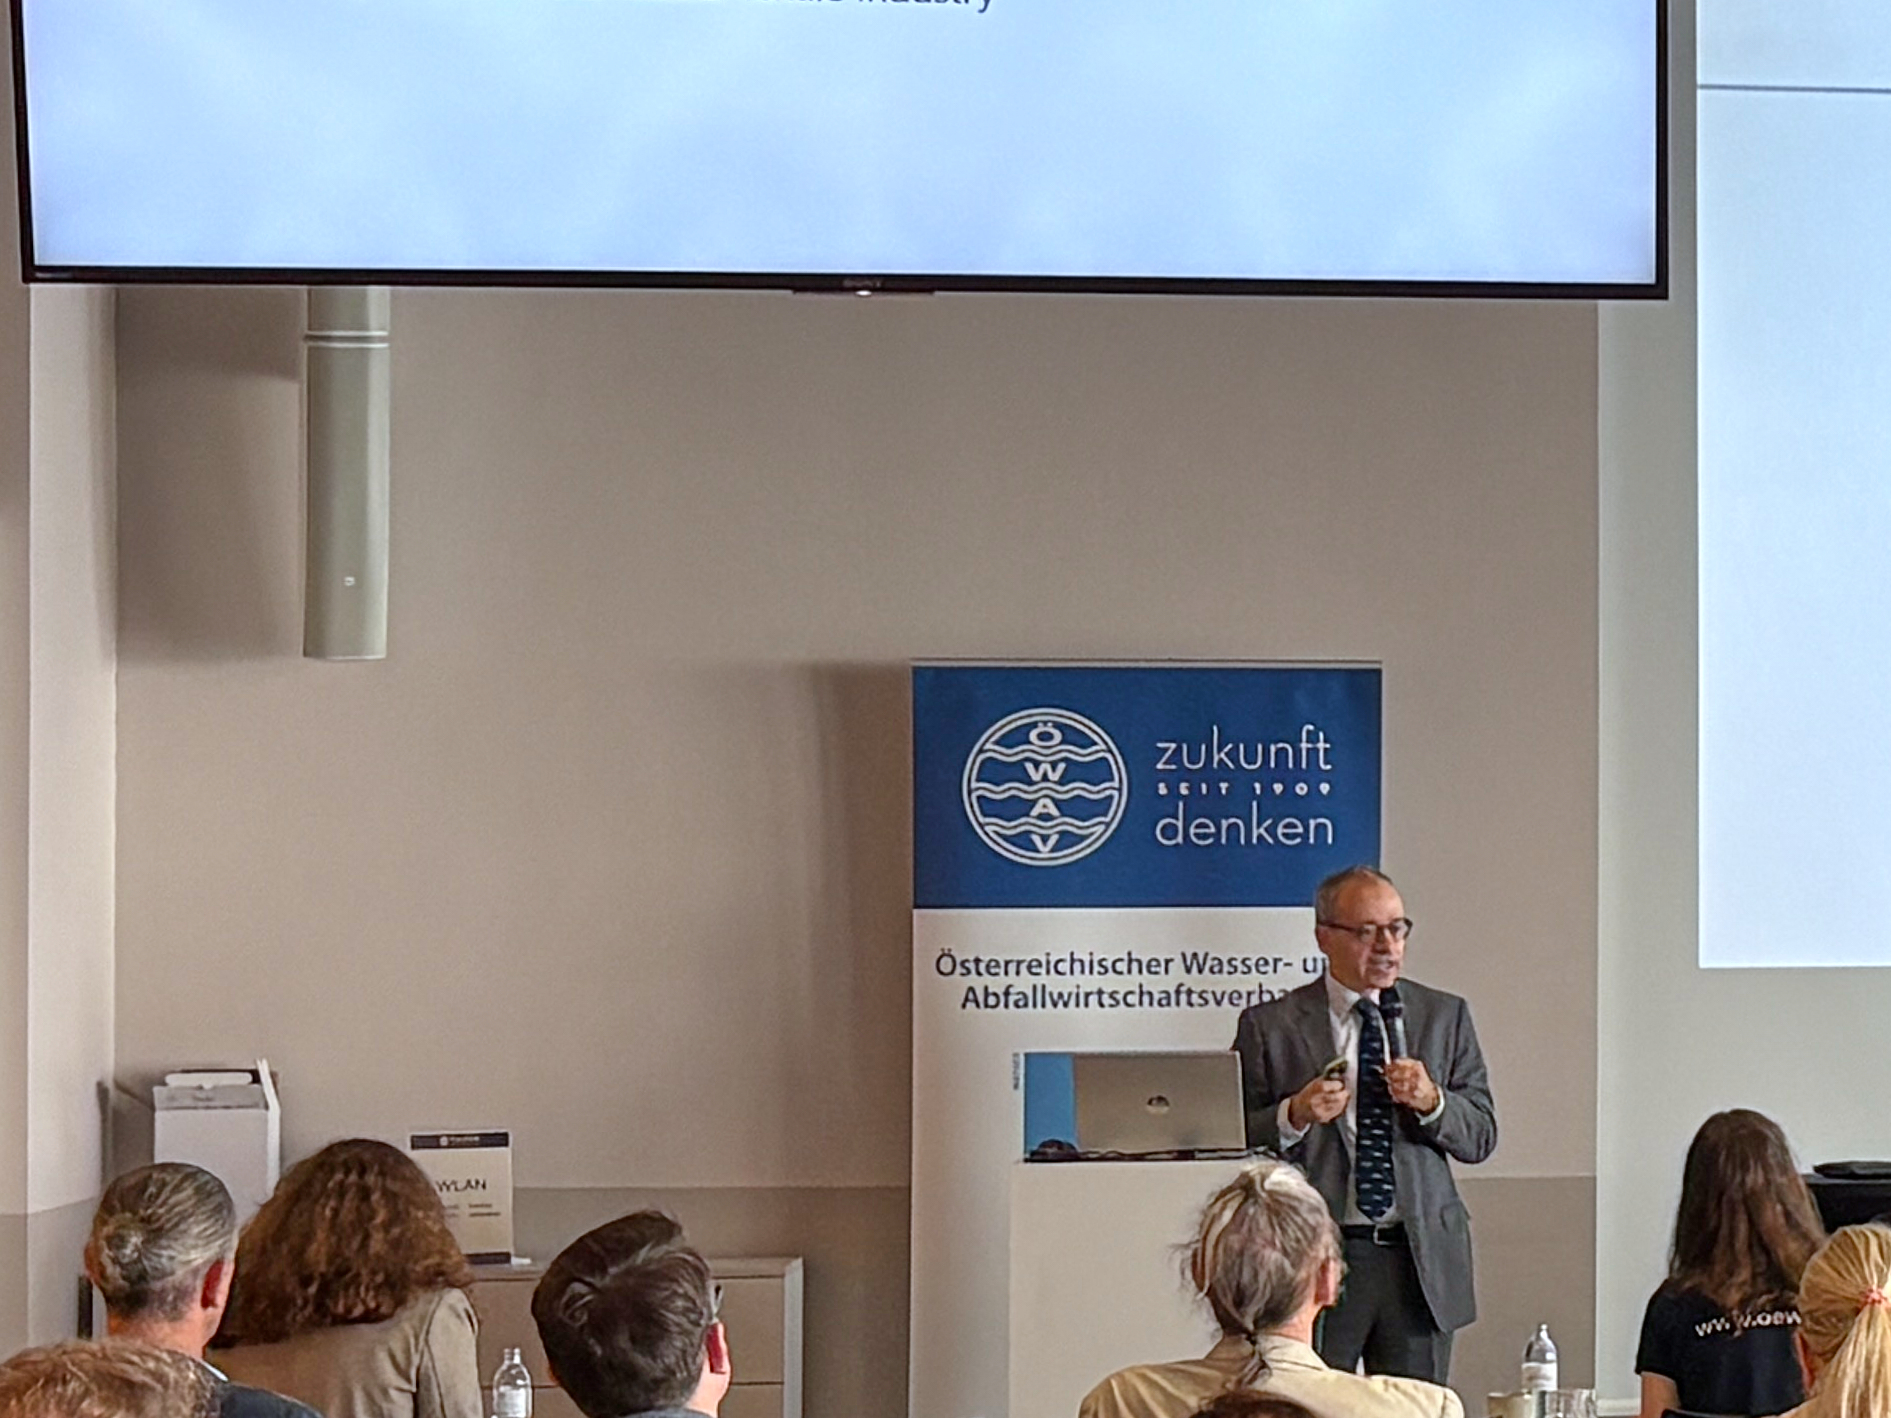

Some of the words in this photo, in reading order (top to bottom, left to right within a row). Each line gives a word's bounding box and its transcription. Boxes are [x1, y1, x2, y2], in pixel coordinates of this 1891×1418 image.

[1155, 724, 1332, 771] zukunft
[1157, 782, 1229, 796] SEIT
[1253, 782, 1331, 796] 1909
[1155, 800, 1333, 846] denken
[935, 948, 1175, 978] Österreichischer
[1180, 951, 1293, 976] Wasser-
[435, 1178, 487, 1193] WLAN
